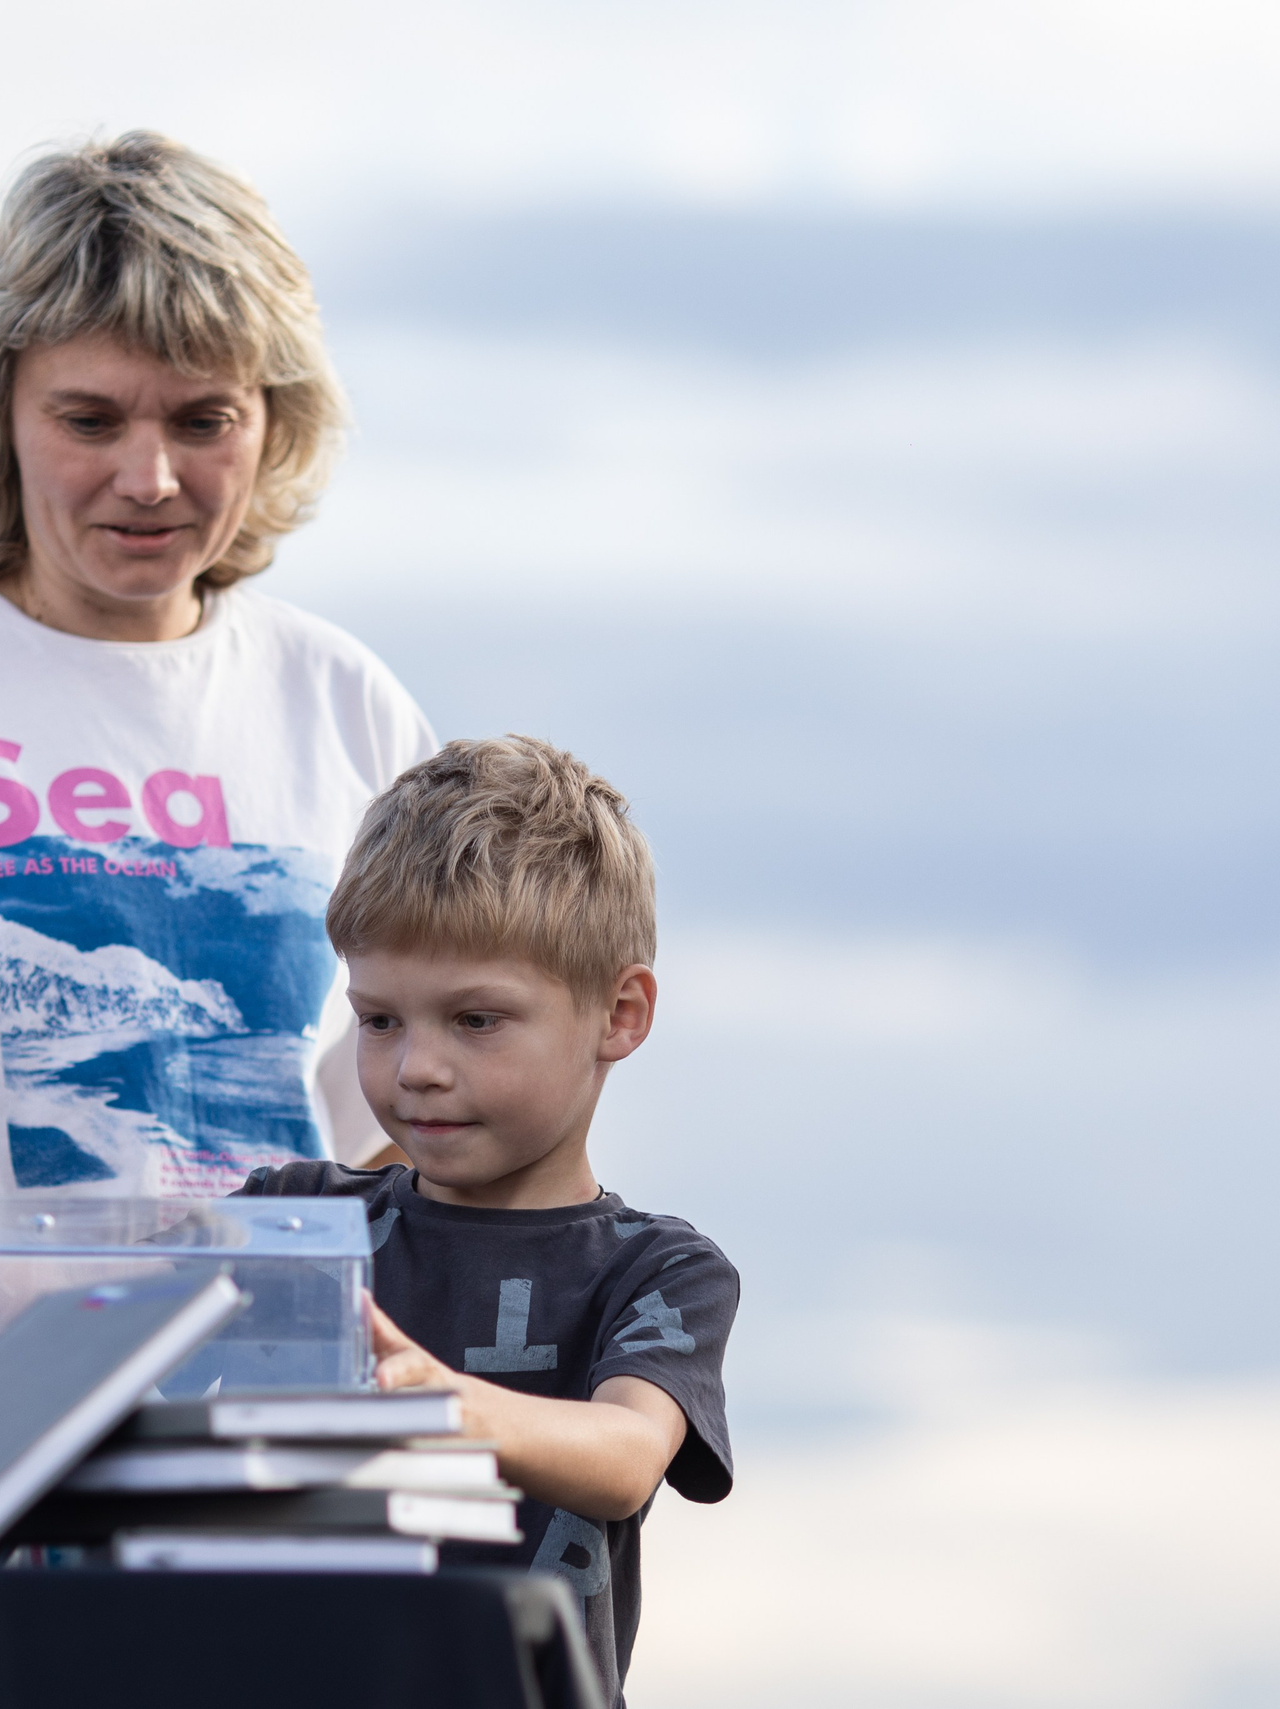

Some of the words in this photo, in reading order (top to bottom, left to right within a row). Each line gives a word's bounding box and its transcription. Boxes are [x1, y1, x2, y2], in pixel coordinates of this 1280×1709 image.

[23, 857, 54, 875] AS
[59, 857, 98, 875] THE
[103, 858, 177, 878] OCEAN
